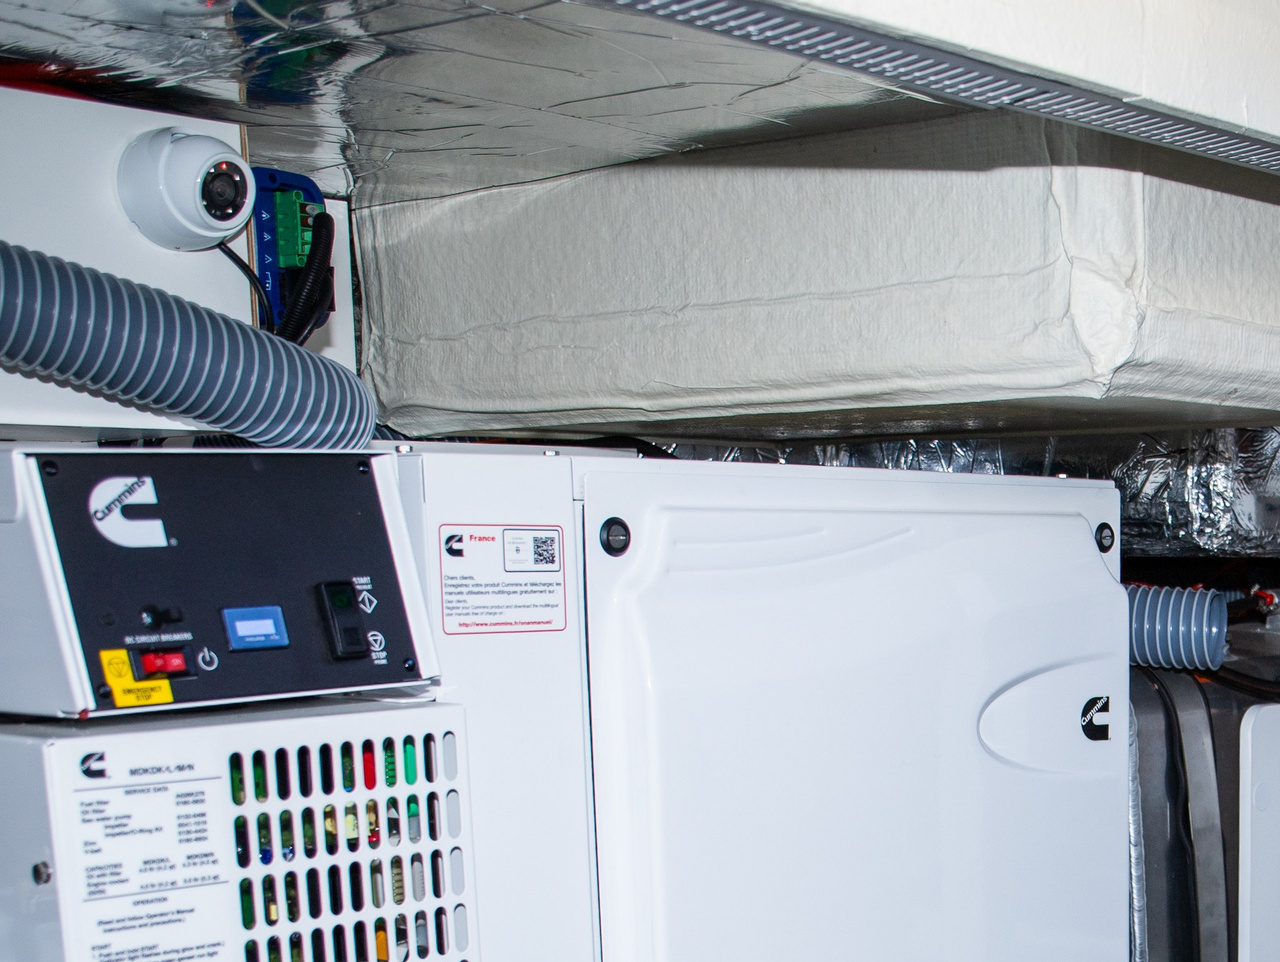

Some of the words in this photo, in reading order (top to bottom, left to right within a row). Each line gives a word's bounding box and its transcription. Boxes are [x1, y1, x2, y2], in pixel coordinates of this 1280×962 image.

[469, 534, 496, 542] France
[352, 576, 371, 584] START
[371, 651, 388, 660] STOP
[122, 686, 162, 696] EMERGENCY
